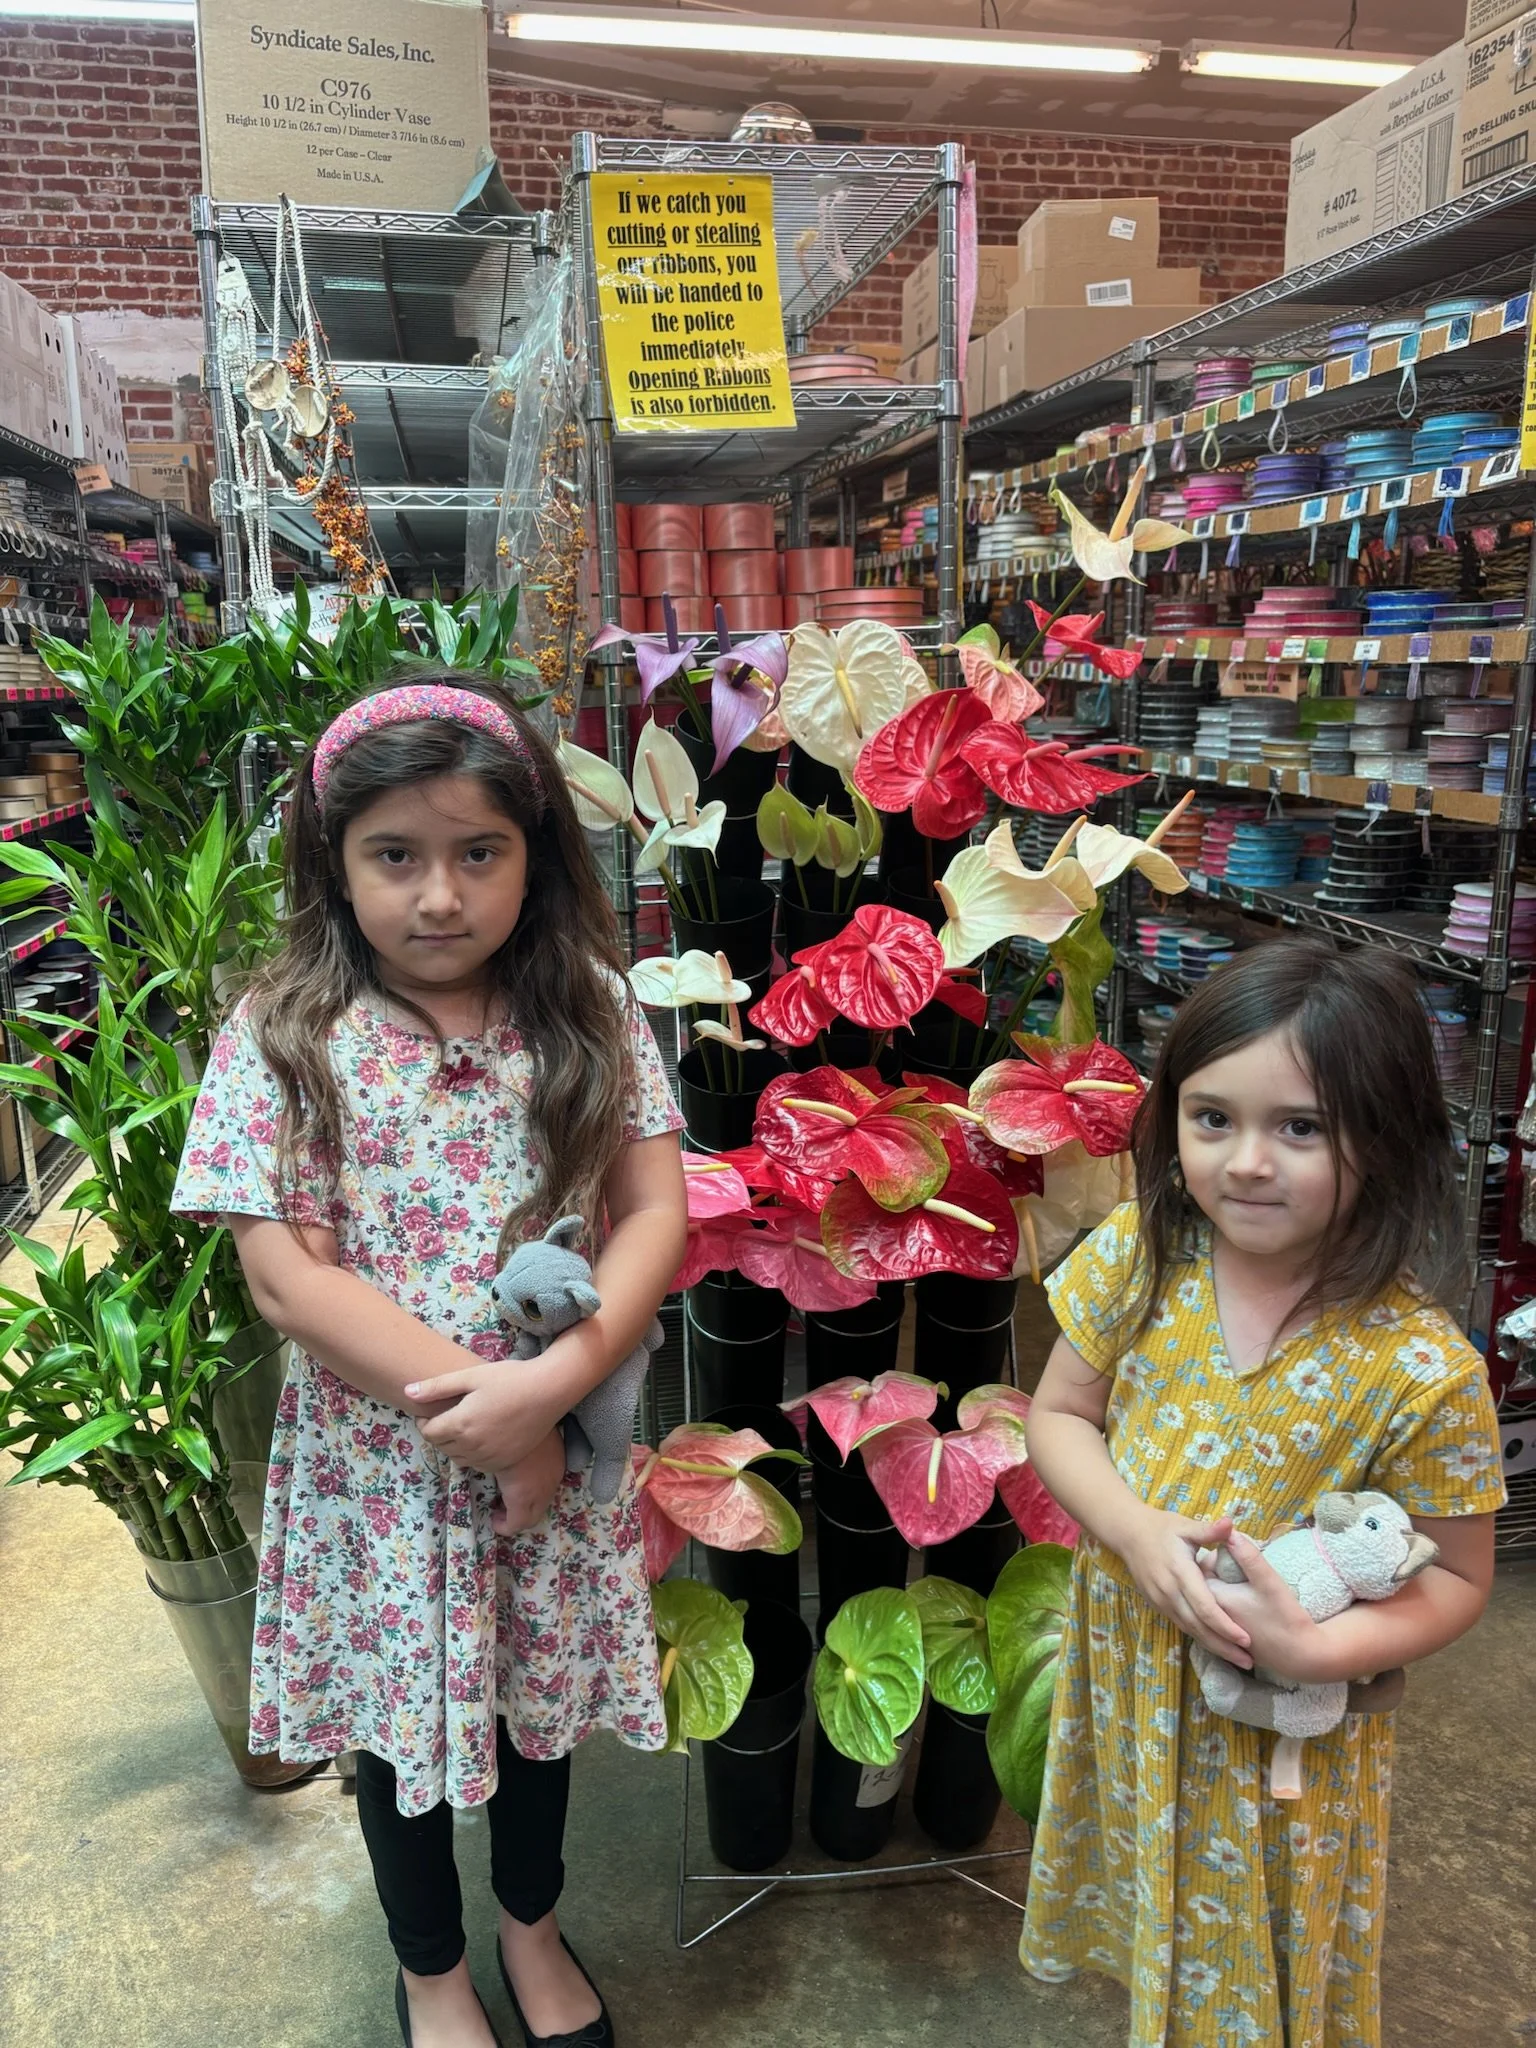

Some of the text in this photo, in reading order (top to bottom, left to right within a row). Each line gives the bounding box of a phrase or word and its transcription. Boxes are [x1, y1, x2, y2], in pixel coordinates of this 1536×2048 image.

[250, 25, 435, 64] Syndicate Sales, Inc.
[1468, 29, 1515, 69] 162354
[320, 78, 372, 101] C976
[262, 94, 432, 126] 10 1/2 in Cylinder Vase
[1391, 99, 1425, 129] Recycled
[226, 113, 258, 128] Height
[260, 116, 271, 128] 10
[272, 117, 286, 130] 1/2
[288, 119, 298, 131] in
[299, 121, 322, 134] (26.7
[324, 123, 342, 136] cm)
[349, 125, 390, 141] Diameter
[391, 129, 398, 140] 3
[399, 130, 418, 143] 7/16
[419, 132, 429, 144] in
[430, 134, 447, 146] (8.6
[448, 136, 465, 149] cm)
[1462, 127, 1478, 143] TOP
[1479, 109, 1516, 135] SELLING
[306, 144, 316, 155] 12
[316, 147, 334, 159] per
[336, 146, 358, 159] Case
[367, 149, 392, 162] Clear
[316, 168, 384, 184] Made in U.S.A.
[618, 191, 746, 215] If we catch you
[607, 222, 762, 248] cutting or stealing
[617, 253, 757, 276] our ribbons, you
[616, 281, 763, 305] will be handed to
[651, 310, 735, 335] the police
[640, 338, 746, 361] immediately
[628, 366, 772, 393] Opening Ribbons
[631, 392, 777, 415] is also forbidden.
